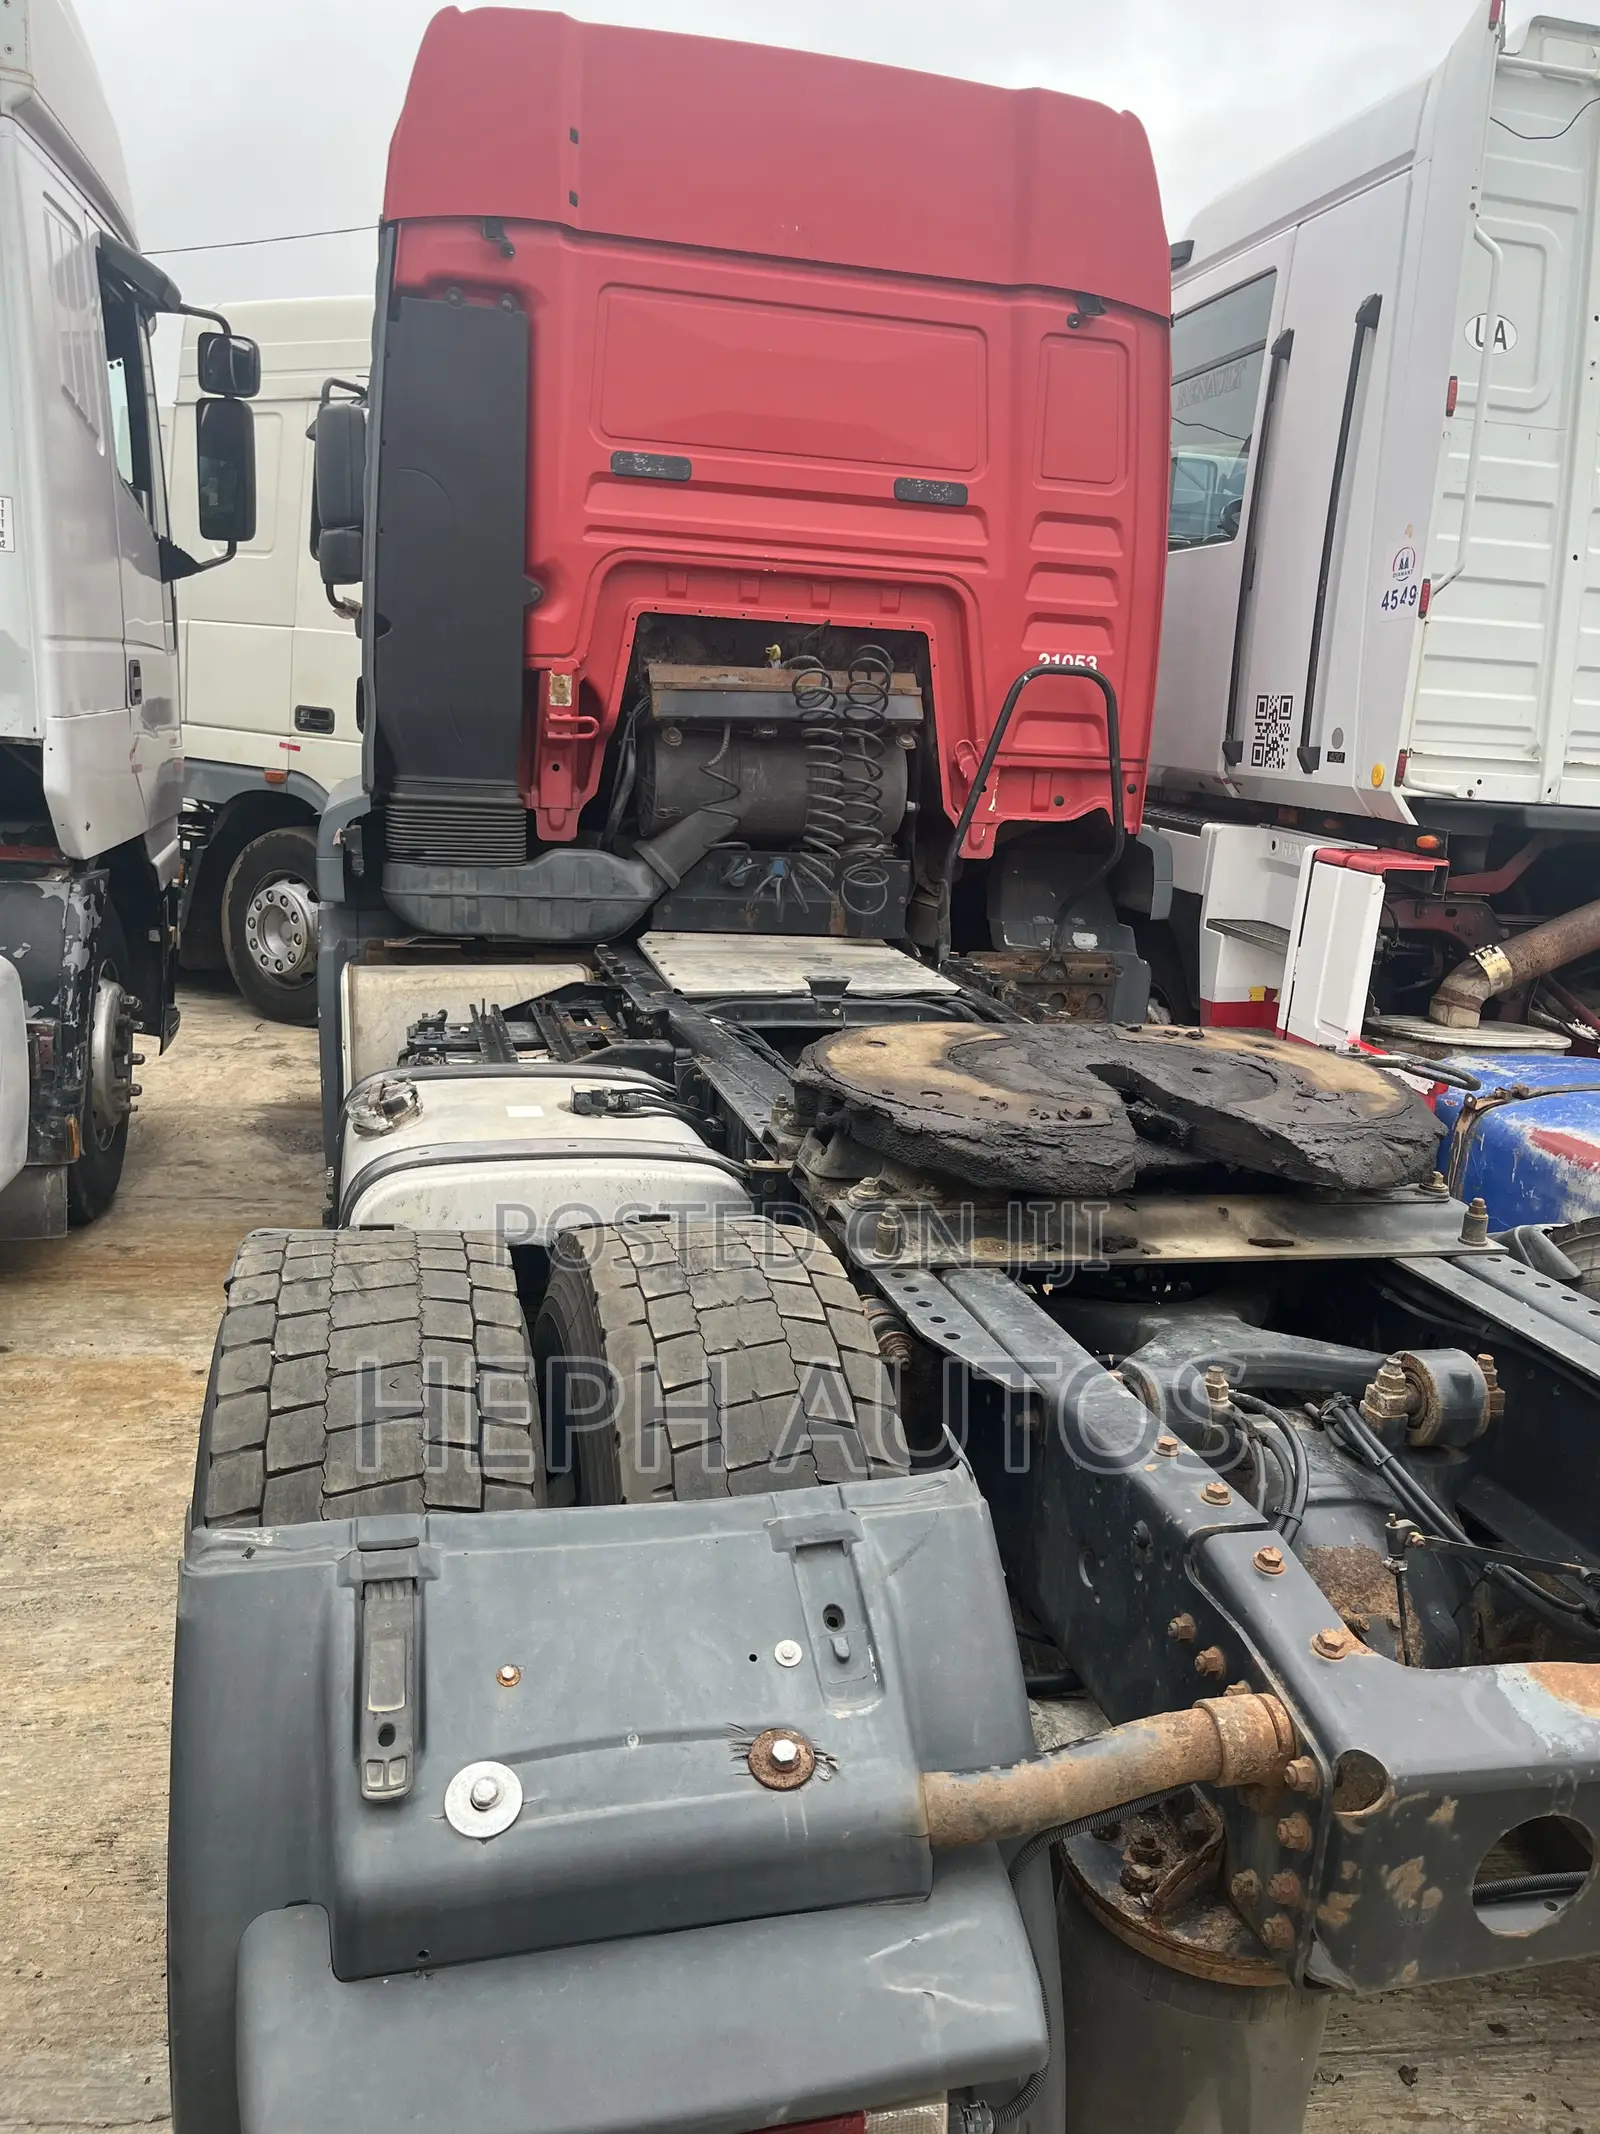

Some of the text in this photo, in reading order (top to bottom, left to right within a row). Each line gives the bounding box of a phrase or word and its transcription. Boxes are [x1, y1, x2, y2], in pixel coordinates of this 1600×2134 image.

[1475, 317, 1507, 350] UA
[1393, 569, 1413, 578] DIAMANT
[1381, 585, 1417, 610] 4549
